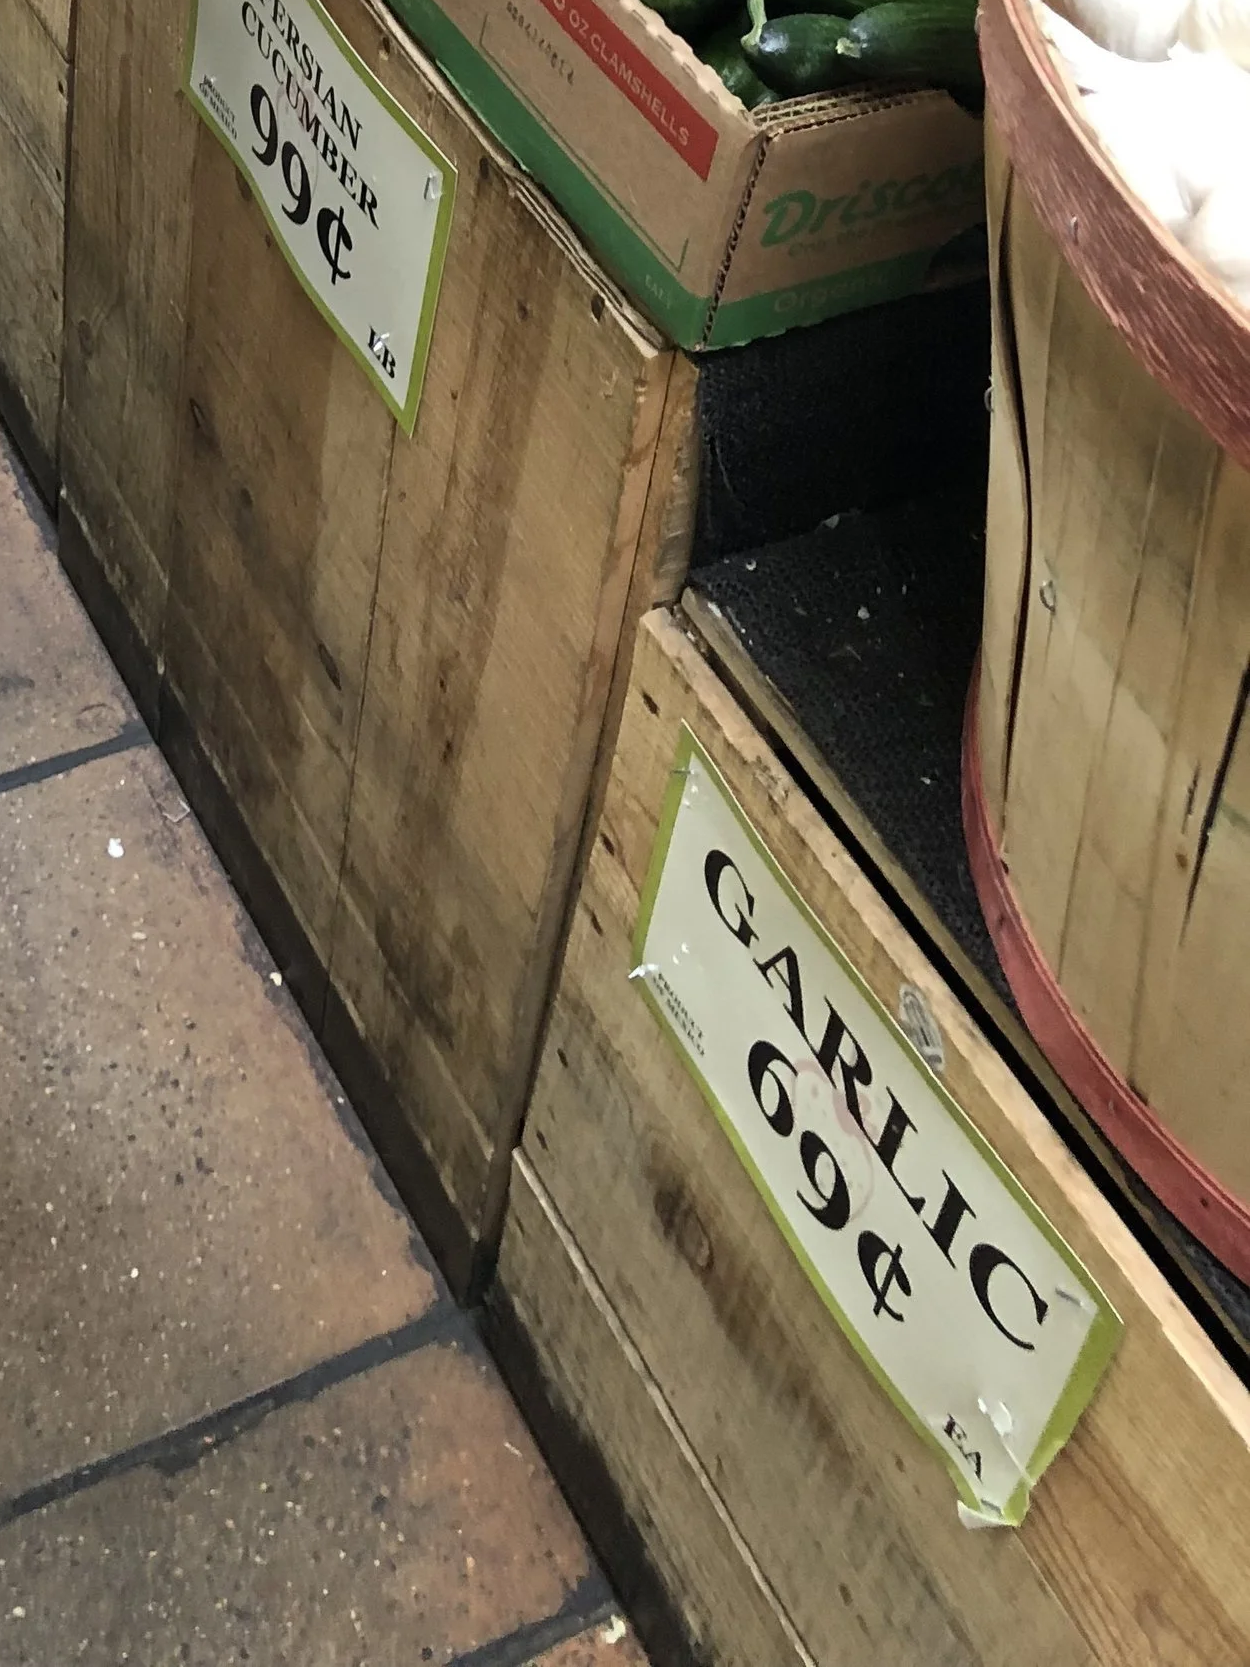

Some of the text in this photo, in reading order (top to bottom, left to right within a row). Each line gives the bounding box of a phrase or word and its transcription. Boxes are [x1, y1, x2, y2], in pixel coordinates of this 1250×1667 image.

[241, 1, 379, 230] CUCUMBER
[250, 84, 353, 285] 99¢
[589, 33, 690, 148] CLAMSHELLS
[367, 325, 396, 380] LB
[703, 848, 1049, 1352] GARLIC
[747, 1038, 914, 1323] 69¢
[943, 1412, 985, 1484] EA
